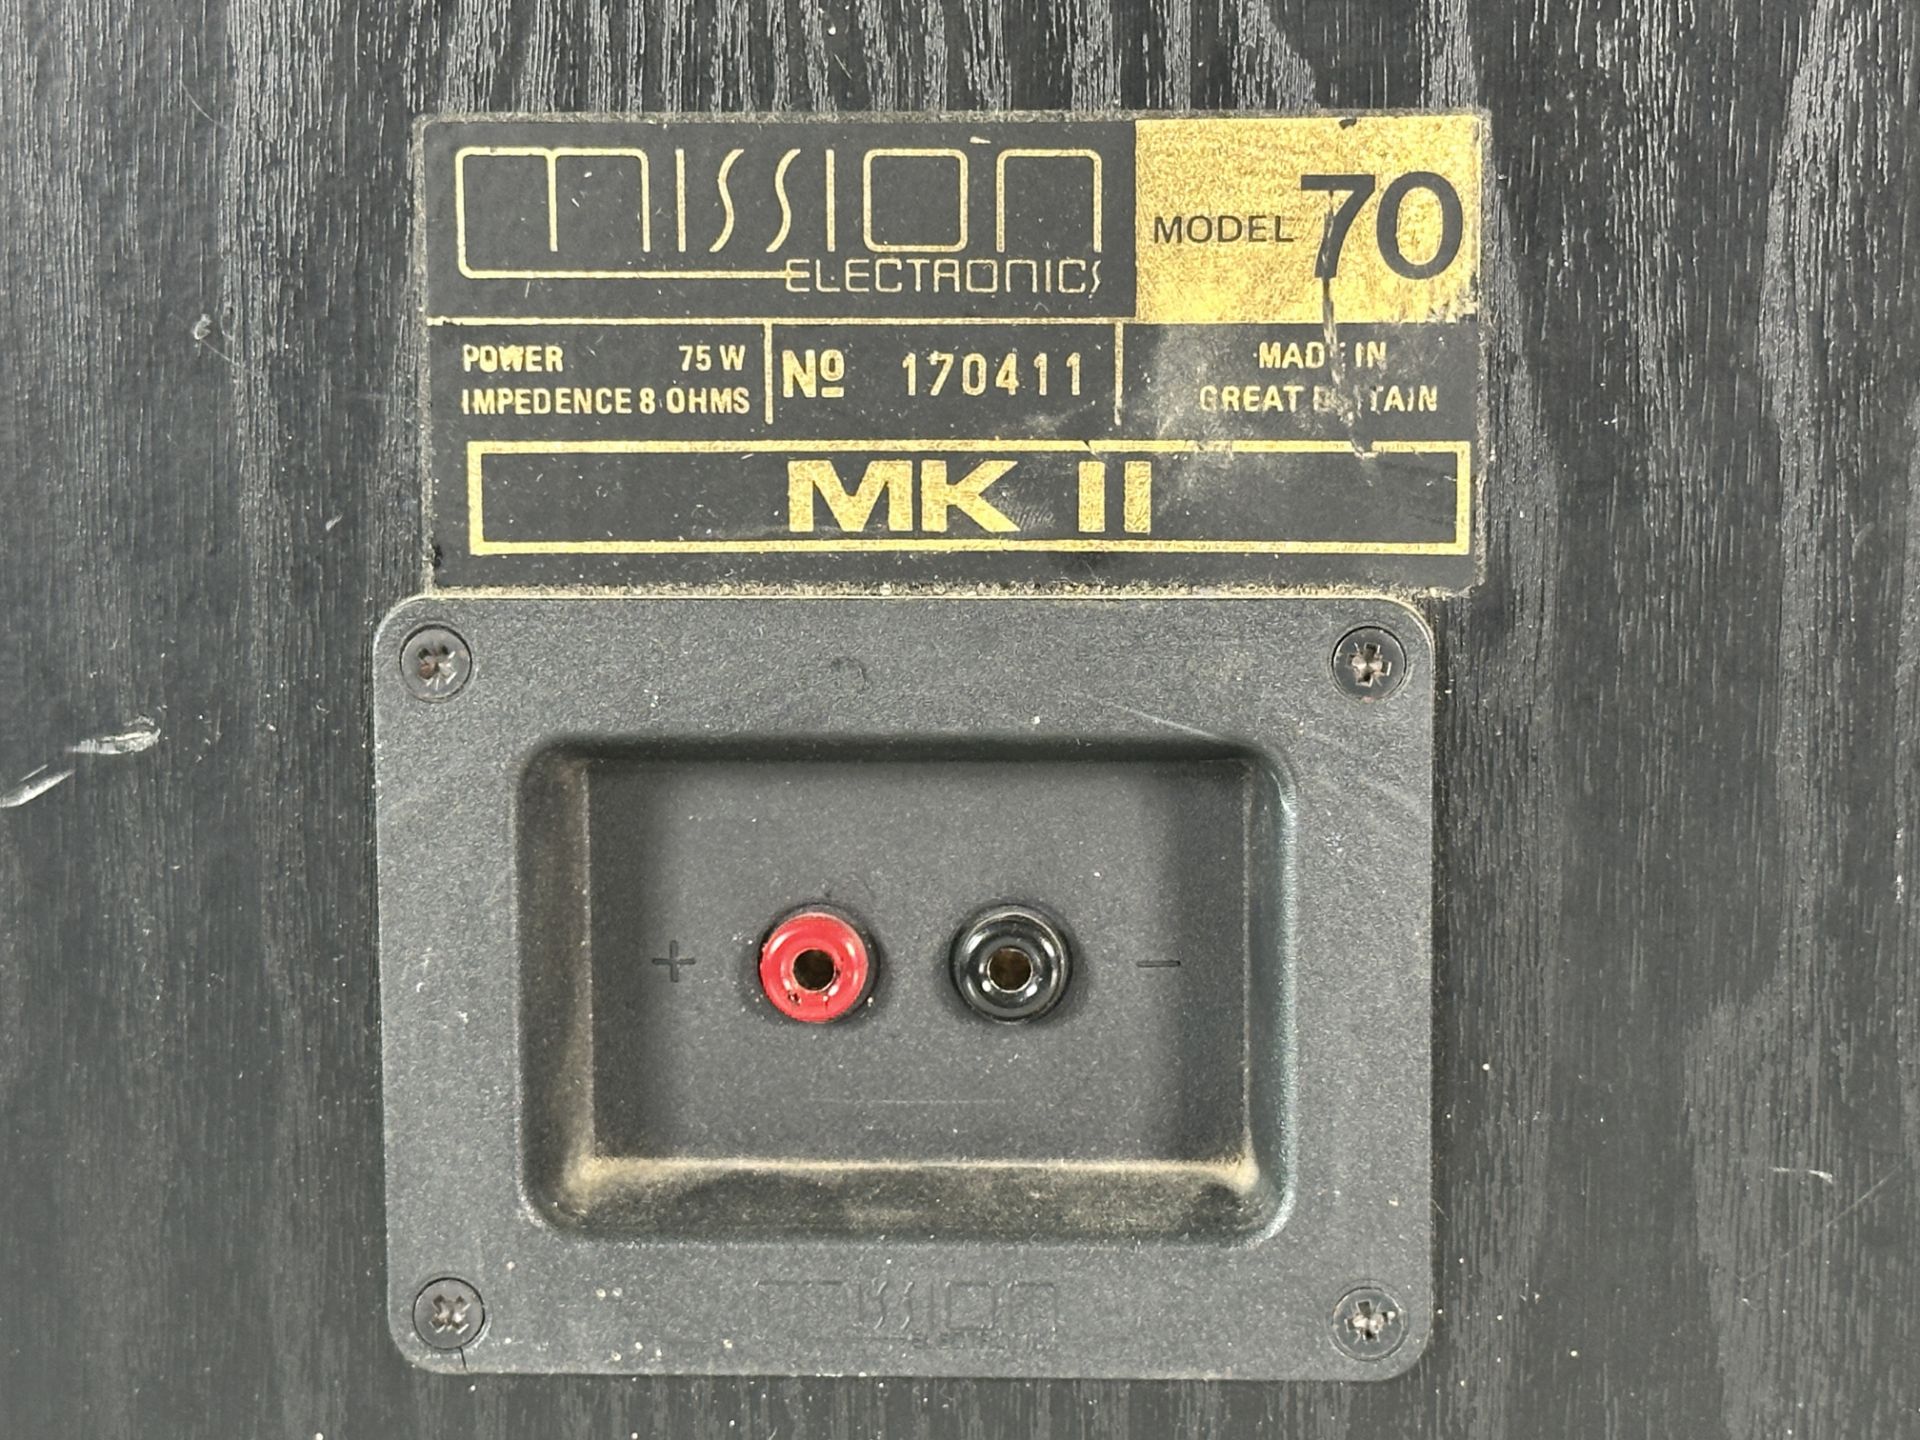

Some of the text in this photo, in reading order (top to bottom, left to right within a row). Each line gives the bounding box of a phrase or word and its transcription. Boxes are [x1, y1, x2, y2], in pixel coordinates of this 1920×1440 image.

[455, 146, 1102, 281] mission
[1154, 171, 1463, 279] MODEL 70
[785, 258, 1101, 292] ELECTRONICS
[462, 344, 746, 372] POWER 75 W
[1259, 341, 1386, 369] MAD IN
[902, 352, 1082, 396] 170411
[462, 387, 750, 414] IMPEDENCE 8 OHMS
[1200, 386, 1305, 412] GREAT
[788, 460, 1152, 534] MK II
